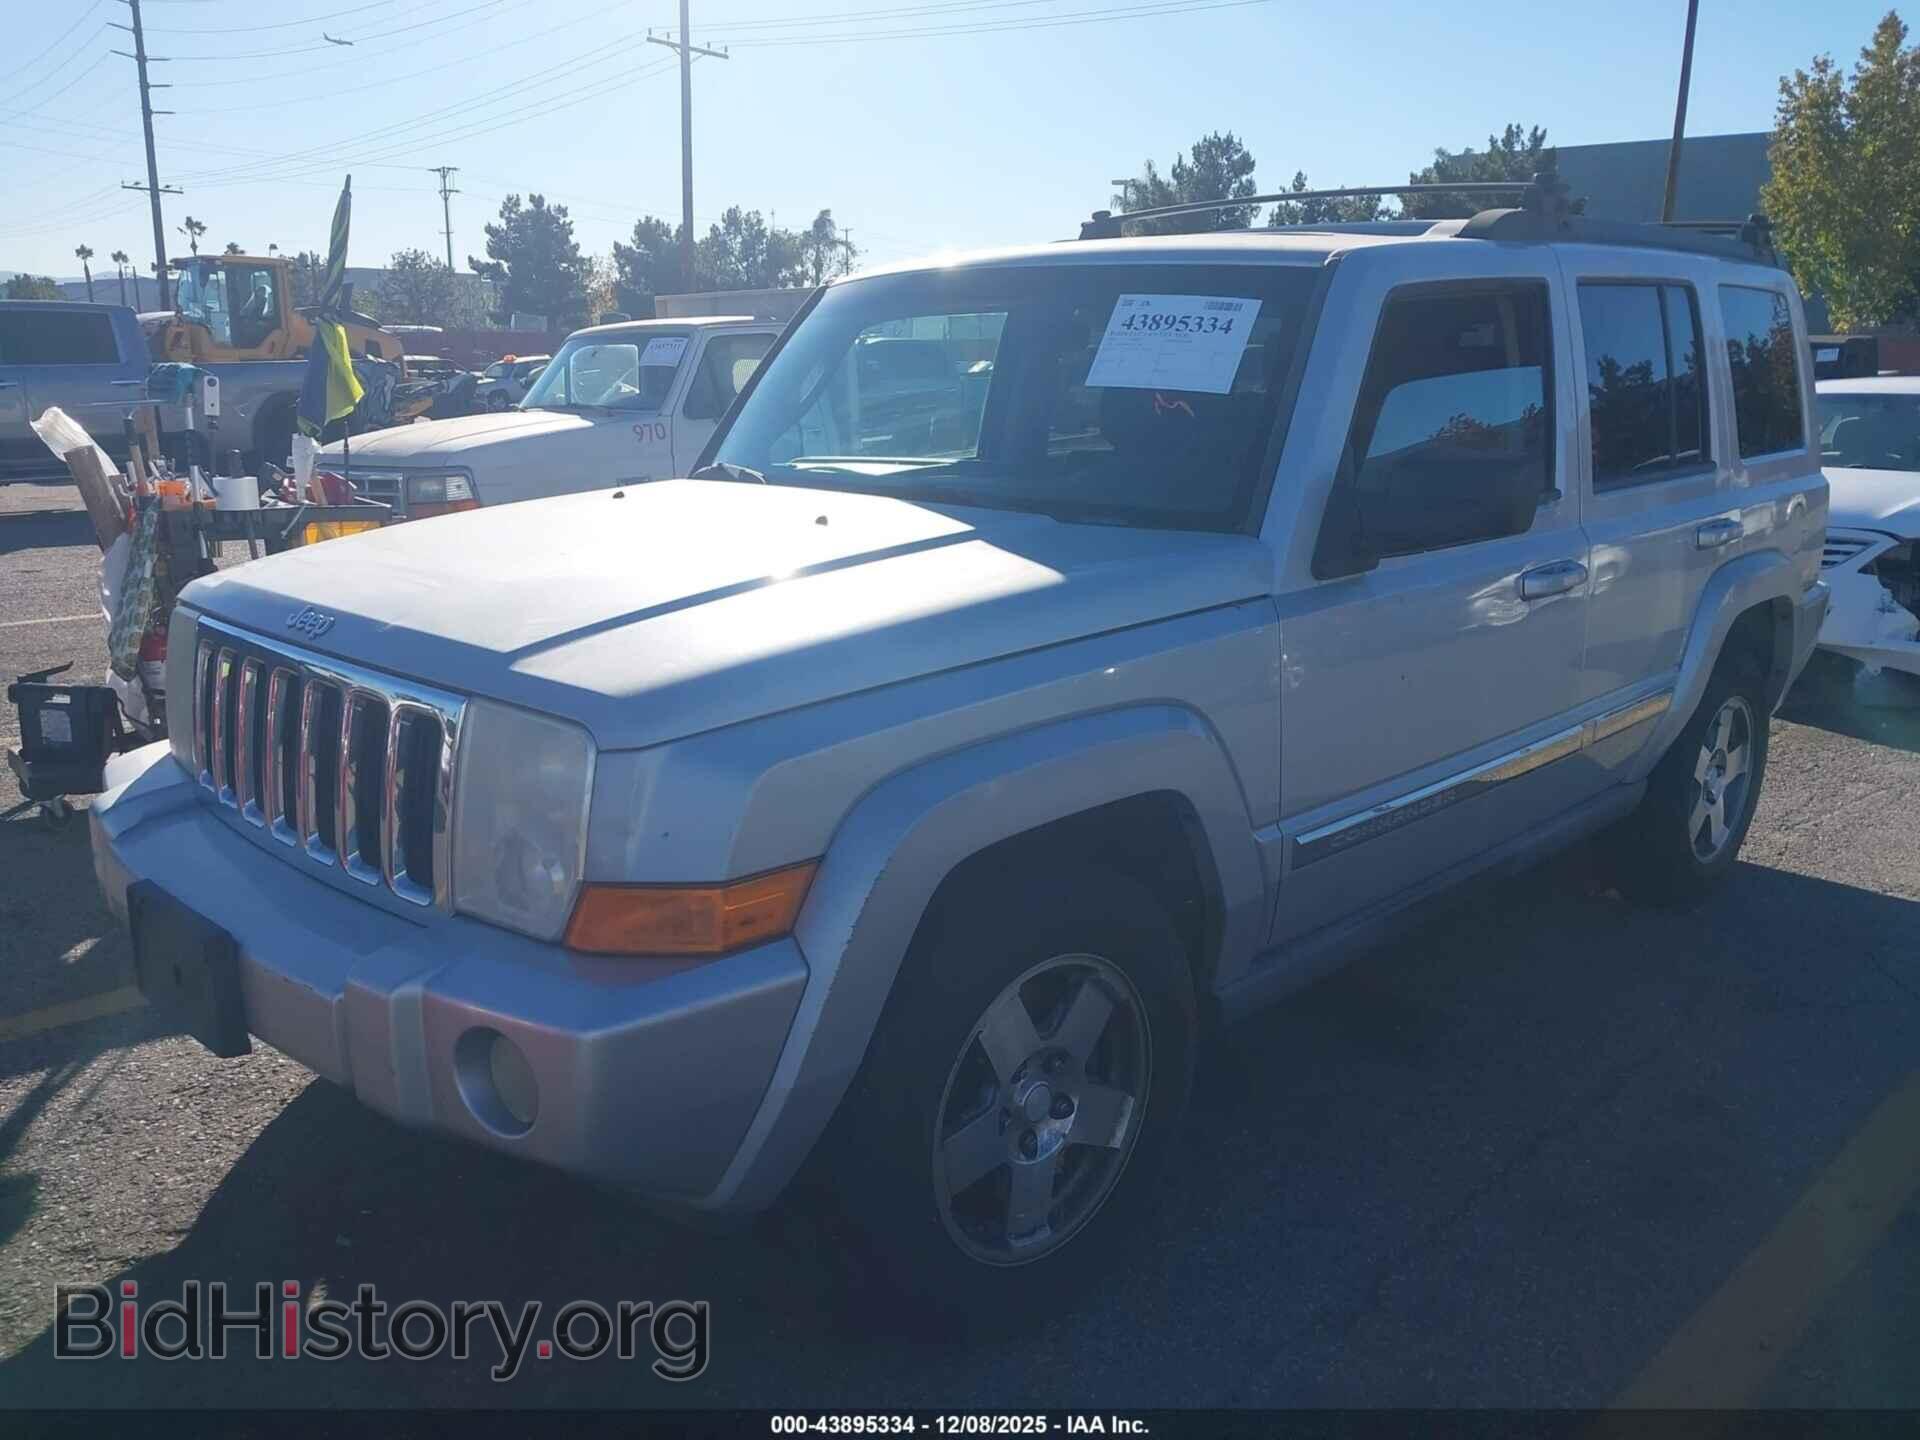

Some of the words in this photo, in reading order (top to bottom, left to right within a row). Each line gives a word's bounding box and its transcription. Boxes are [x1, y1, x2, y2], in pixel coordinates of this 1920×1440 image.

[1121, 313, 1235, 335] 43895334
[632, 422, 666, 443] 970
[286, 604, 335, 640] Jeep
